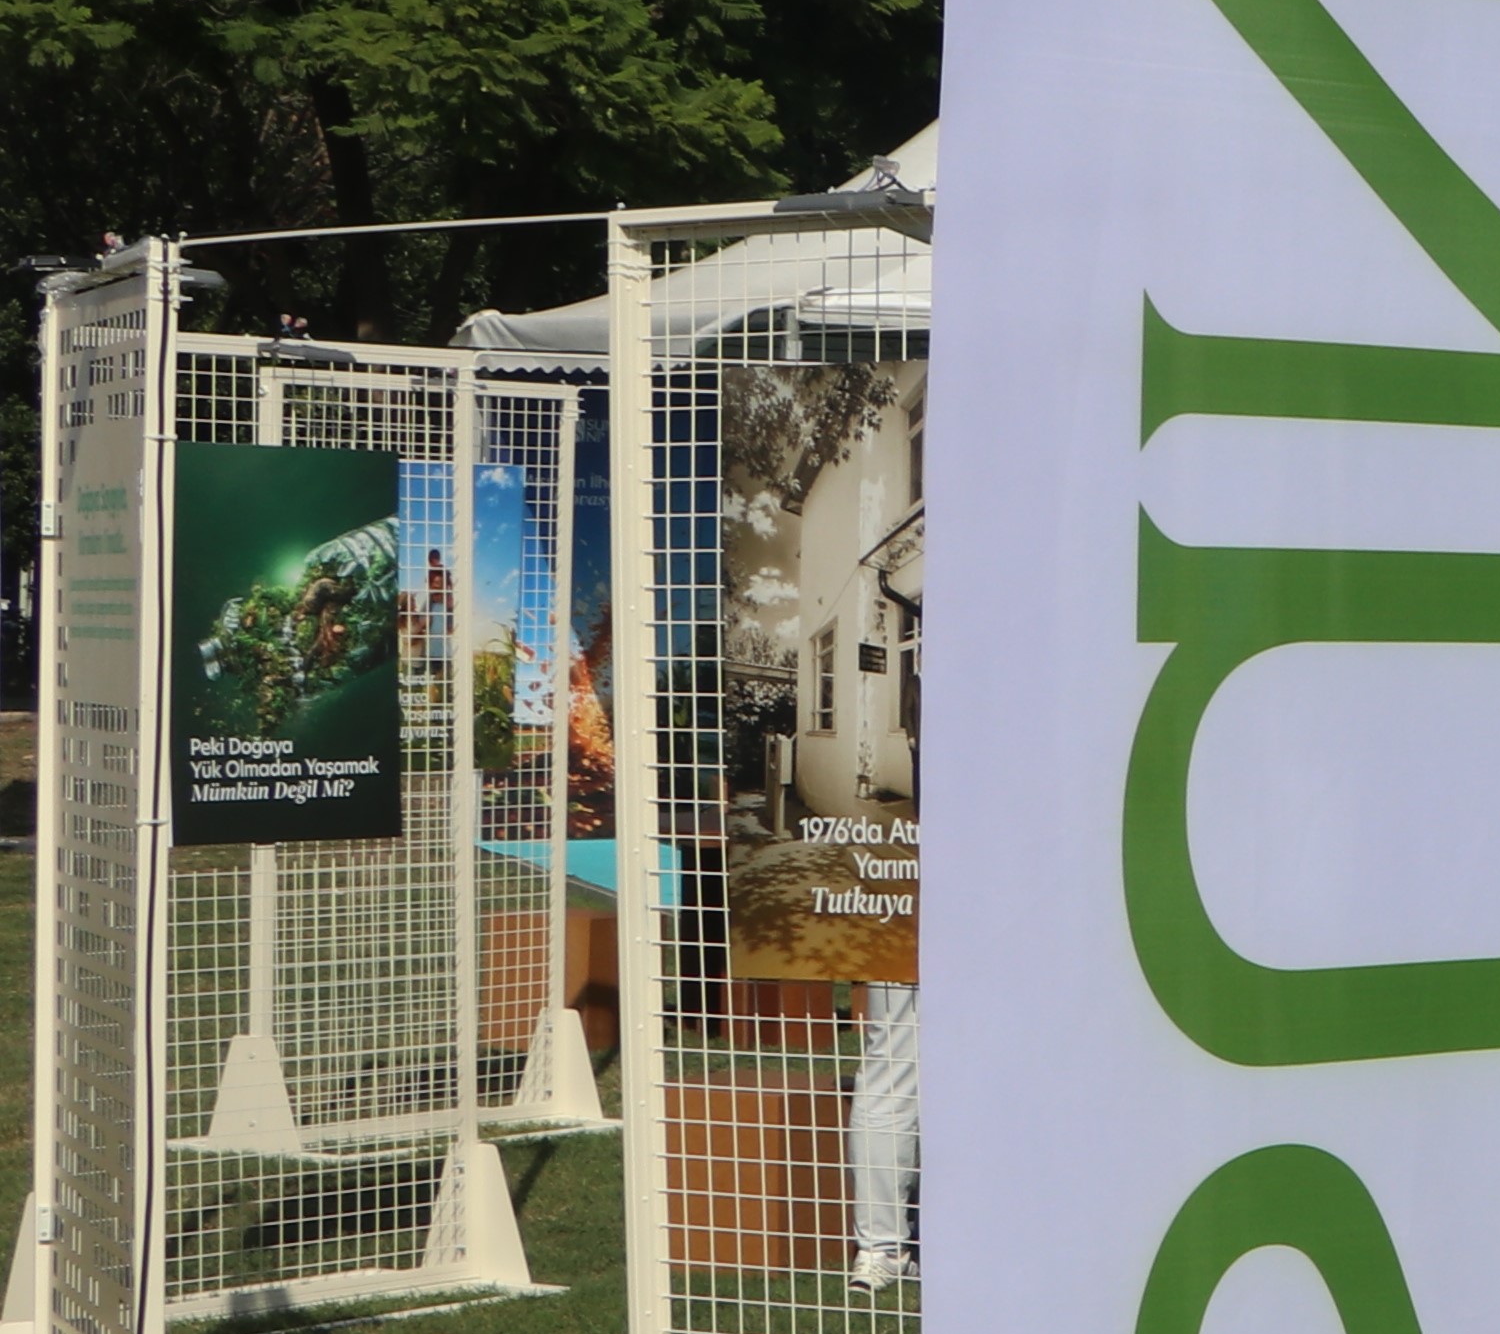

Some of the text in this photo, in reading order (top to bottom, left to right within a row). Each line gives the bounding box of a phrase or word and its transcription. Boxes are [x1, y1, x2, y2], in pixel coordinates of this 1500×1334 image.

[190, 737, 293, 759] Peki Doğaya
[190, 756, 379, 779] Yük Olmadan Yaşamak
[191, 778, 354, 804] Mümkün Değil Mi?
[798, 816, 882, 845] 1976'da
[853, 852, 919, 880] Yarım
[811, 886, 913, 924] Tutkuya
